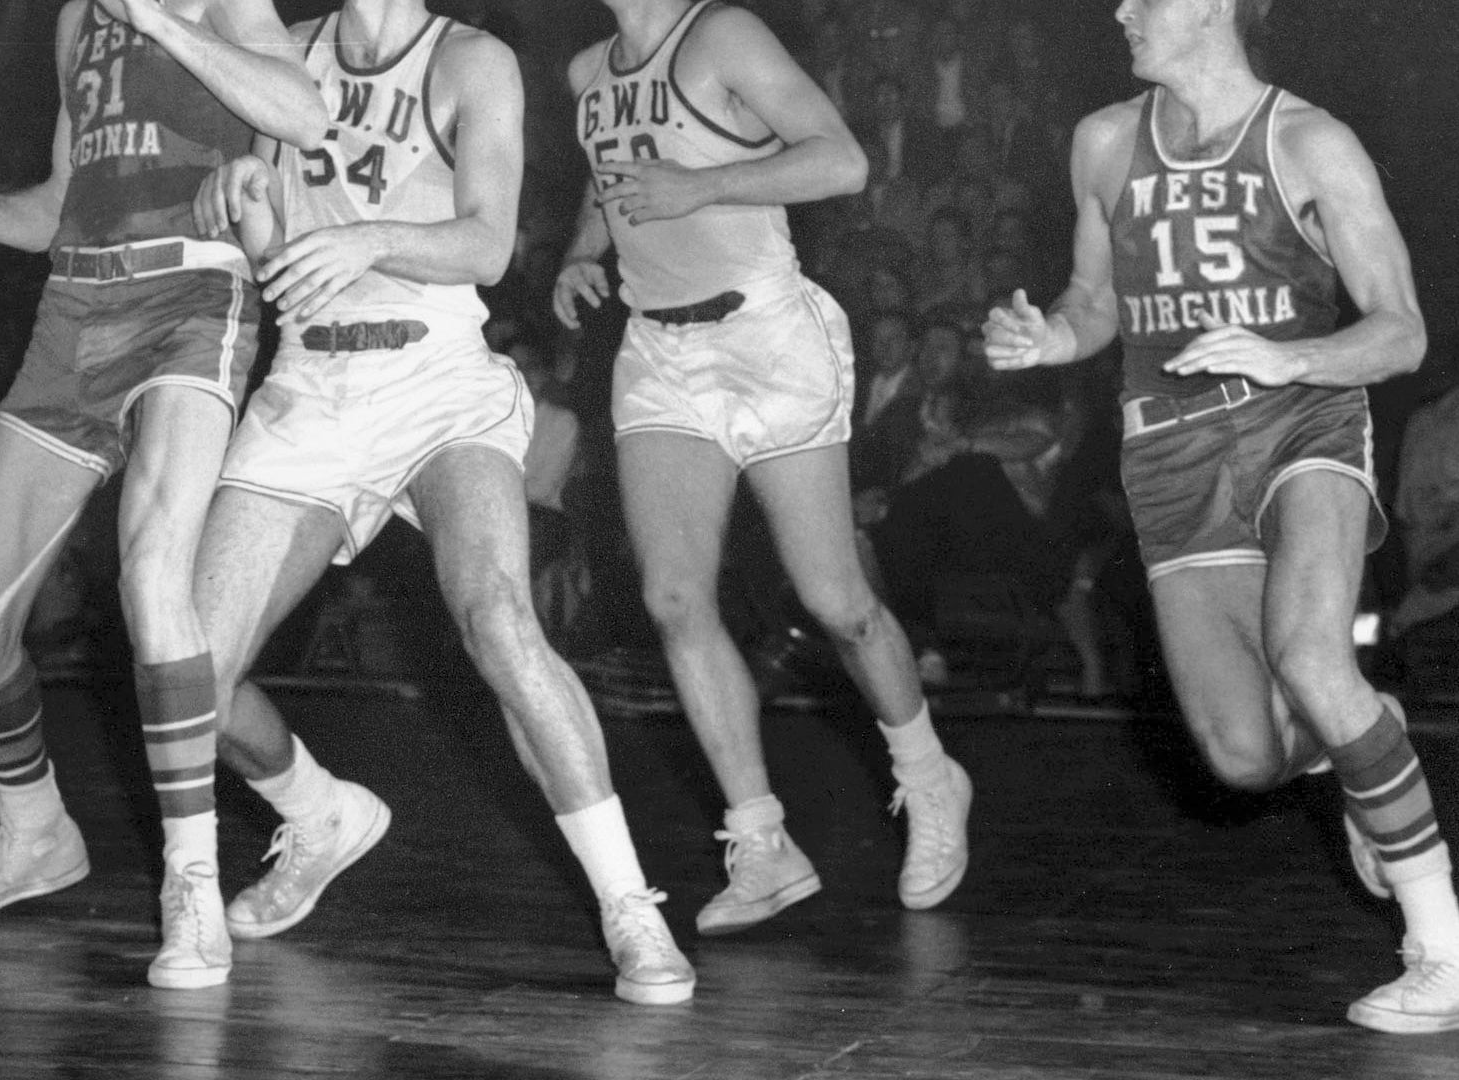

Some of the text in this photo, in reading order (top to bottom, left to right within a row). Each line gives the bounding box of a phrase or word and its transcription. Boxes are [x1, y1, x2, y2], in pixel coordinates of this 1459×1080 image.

[77, 56, 125, 132] 31
[584, 78, 685, 140] G.W.U.
[1130, 170, 1264, 218] WEST
[1150, 215, 1245, 288] 15
[1124, 285, 1298, 336] VIRGINIA
